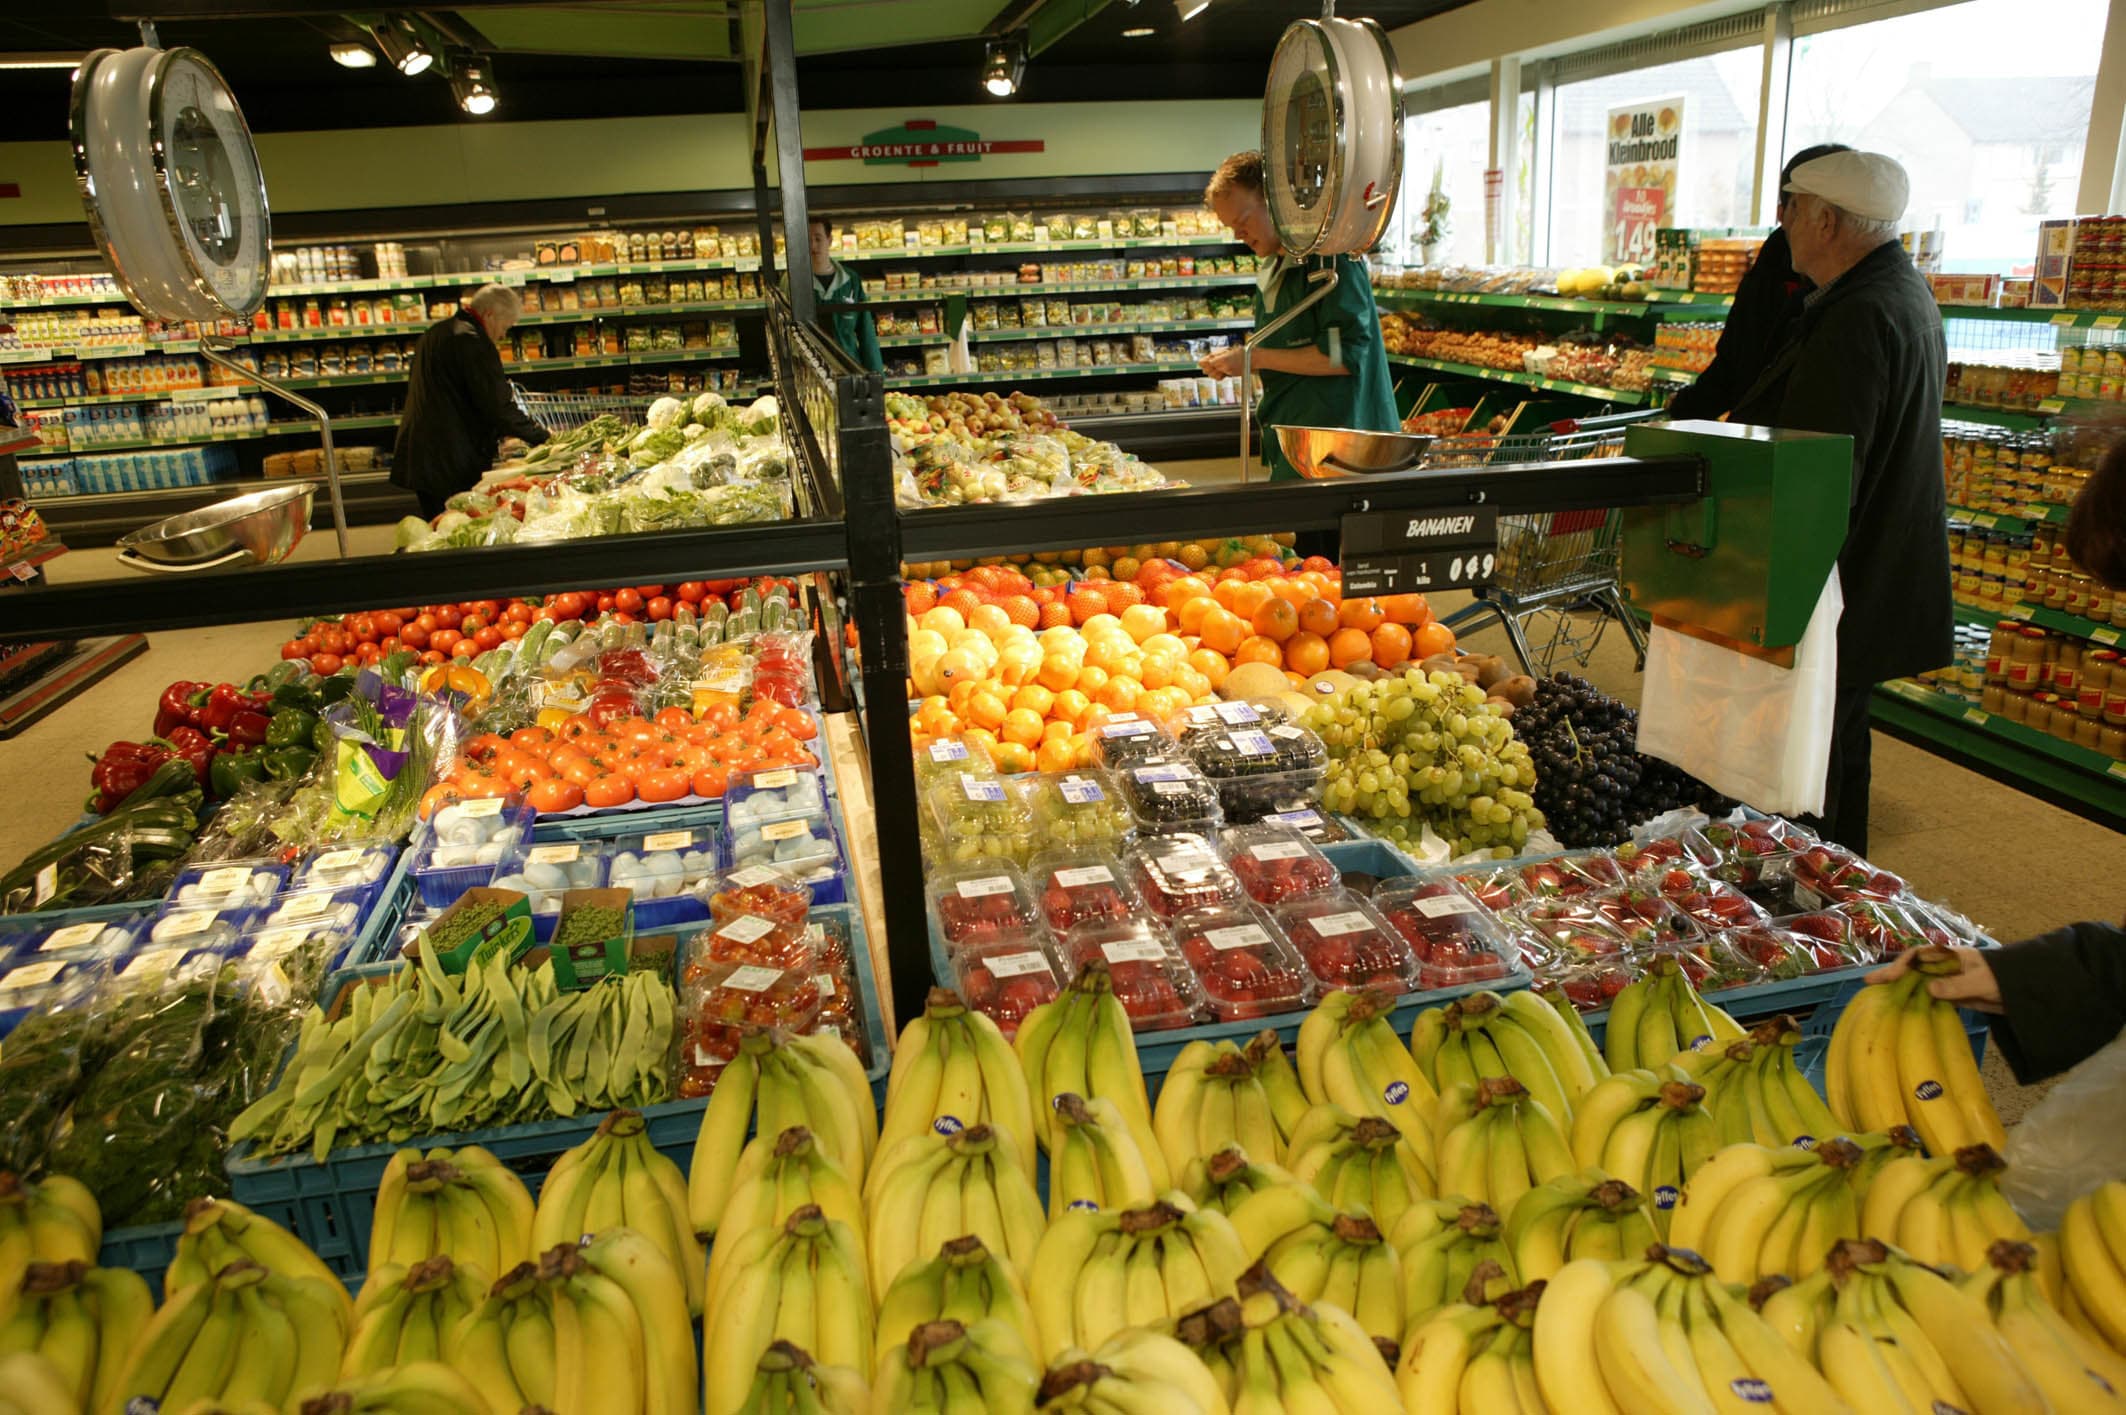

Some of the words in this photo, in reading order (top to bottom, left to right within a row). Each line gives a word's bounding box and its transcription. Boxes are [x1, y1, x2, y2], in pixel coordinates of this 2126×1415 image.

[1631, 112, 1655, 138] Alle
[850, 144, 923, 158] GROENTE
[930, 143, 940, 155] &
[947, 142, 992, 154] FRUIT
[1609, 134, 1678, 166] Kleinbrood
[1406, 515, 1475, 537] BANANEN
[1420, 562, 1427, 574] 1
